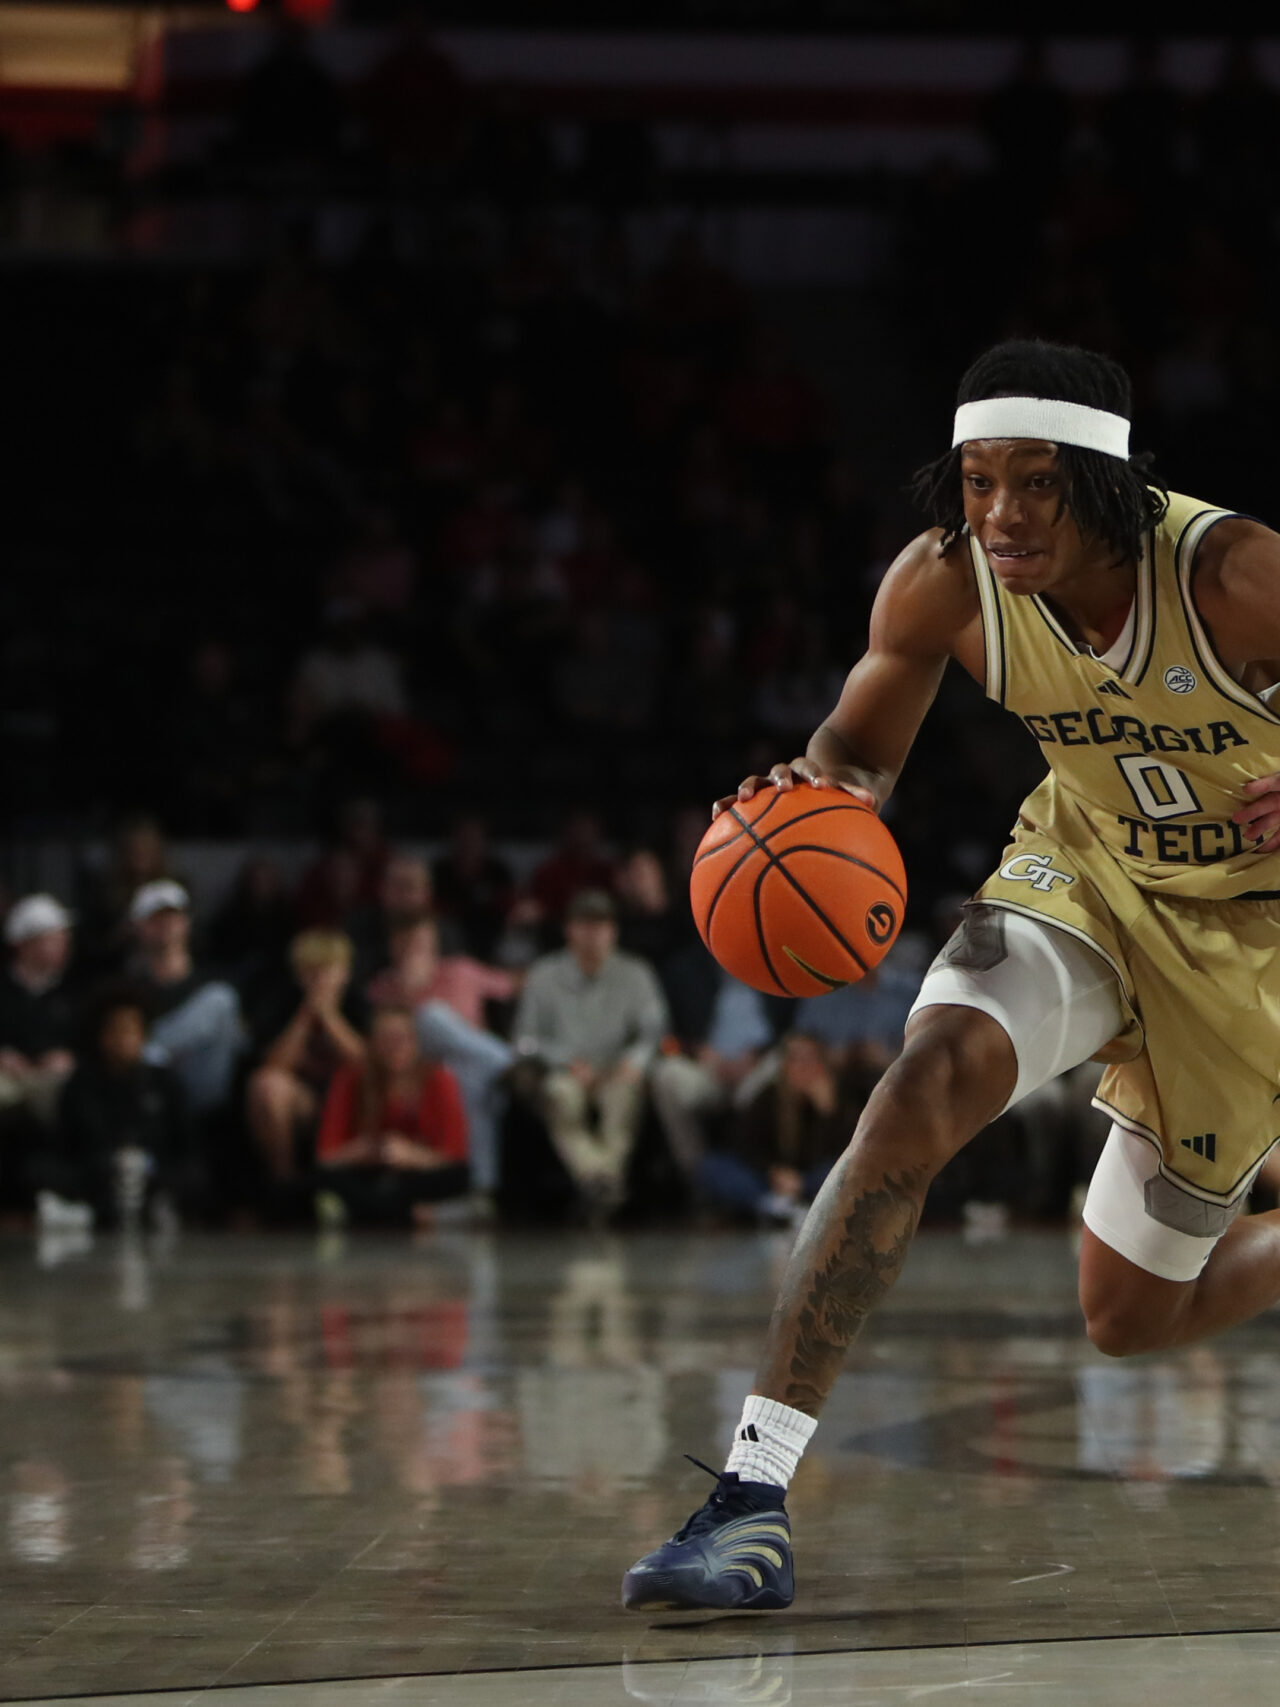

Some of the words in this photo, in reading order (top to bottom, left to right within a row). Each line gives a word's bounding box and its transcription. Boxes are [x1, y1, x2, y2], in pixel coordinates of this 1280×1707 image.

[1169, 674, 1192, 683] ACC
[1023, 708, 1249, 755] GEORGIA
[1114, 752, 1203, 822] 0
[999, 853, 1074, 892] GT
